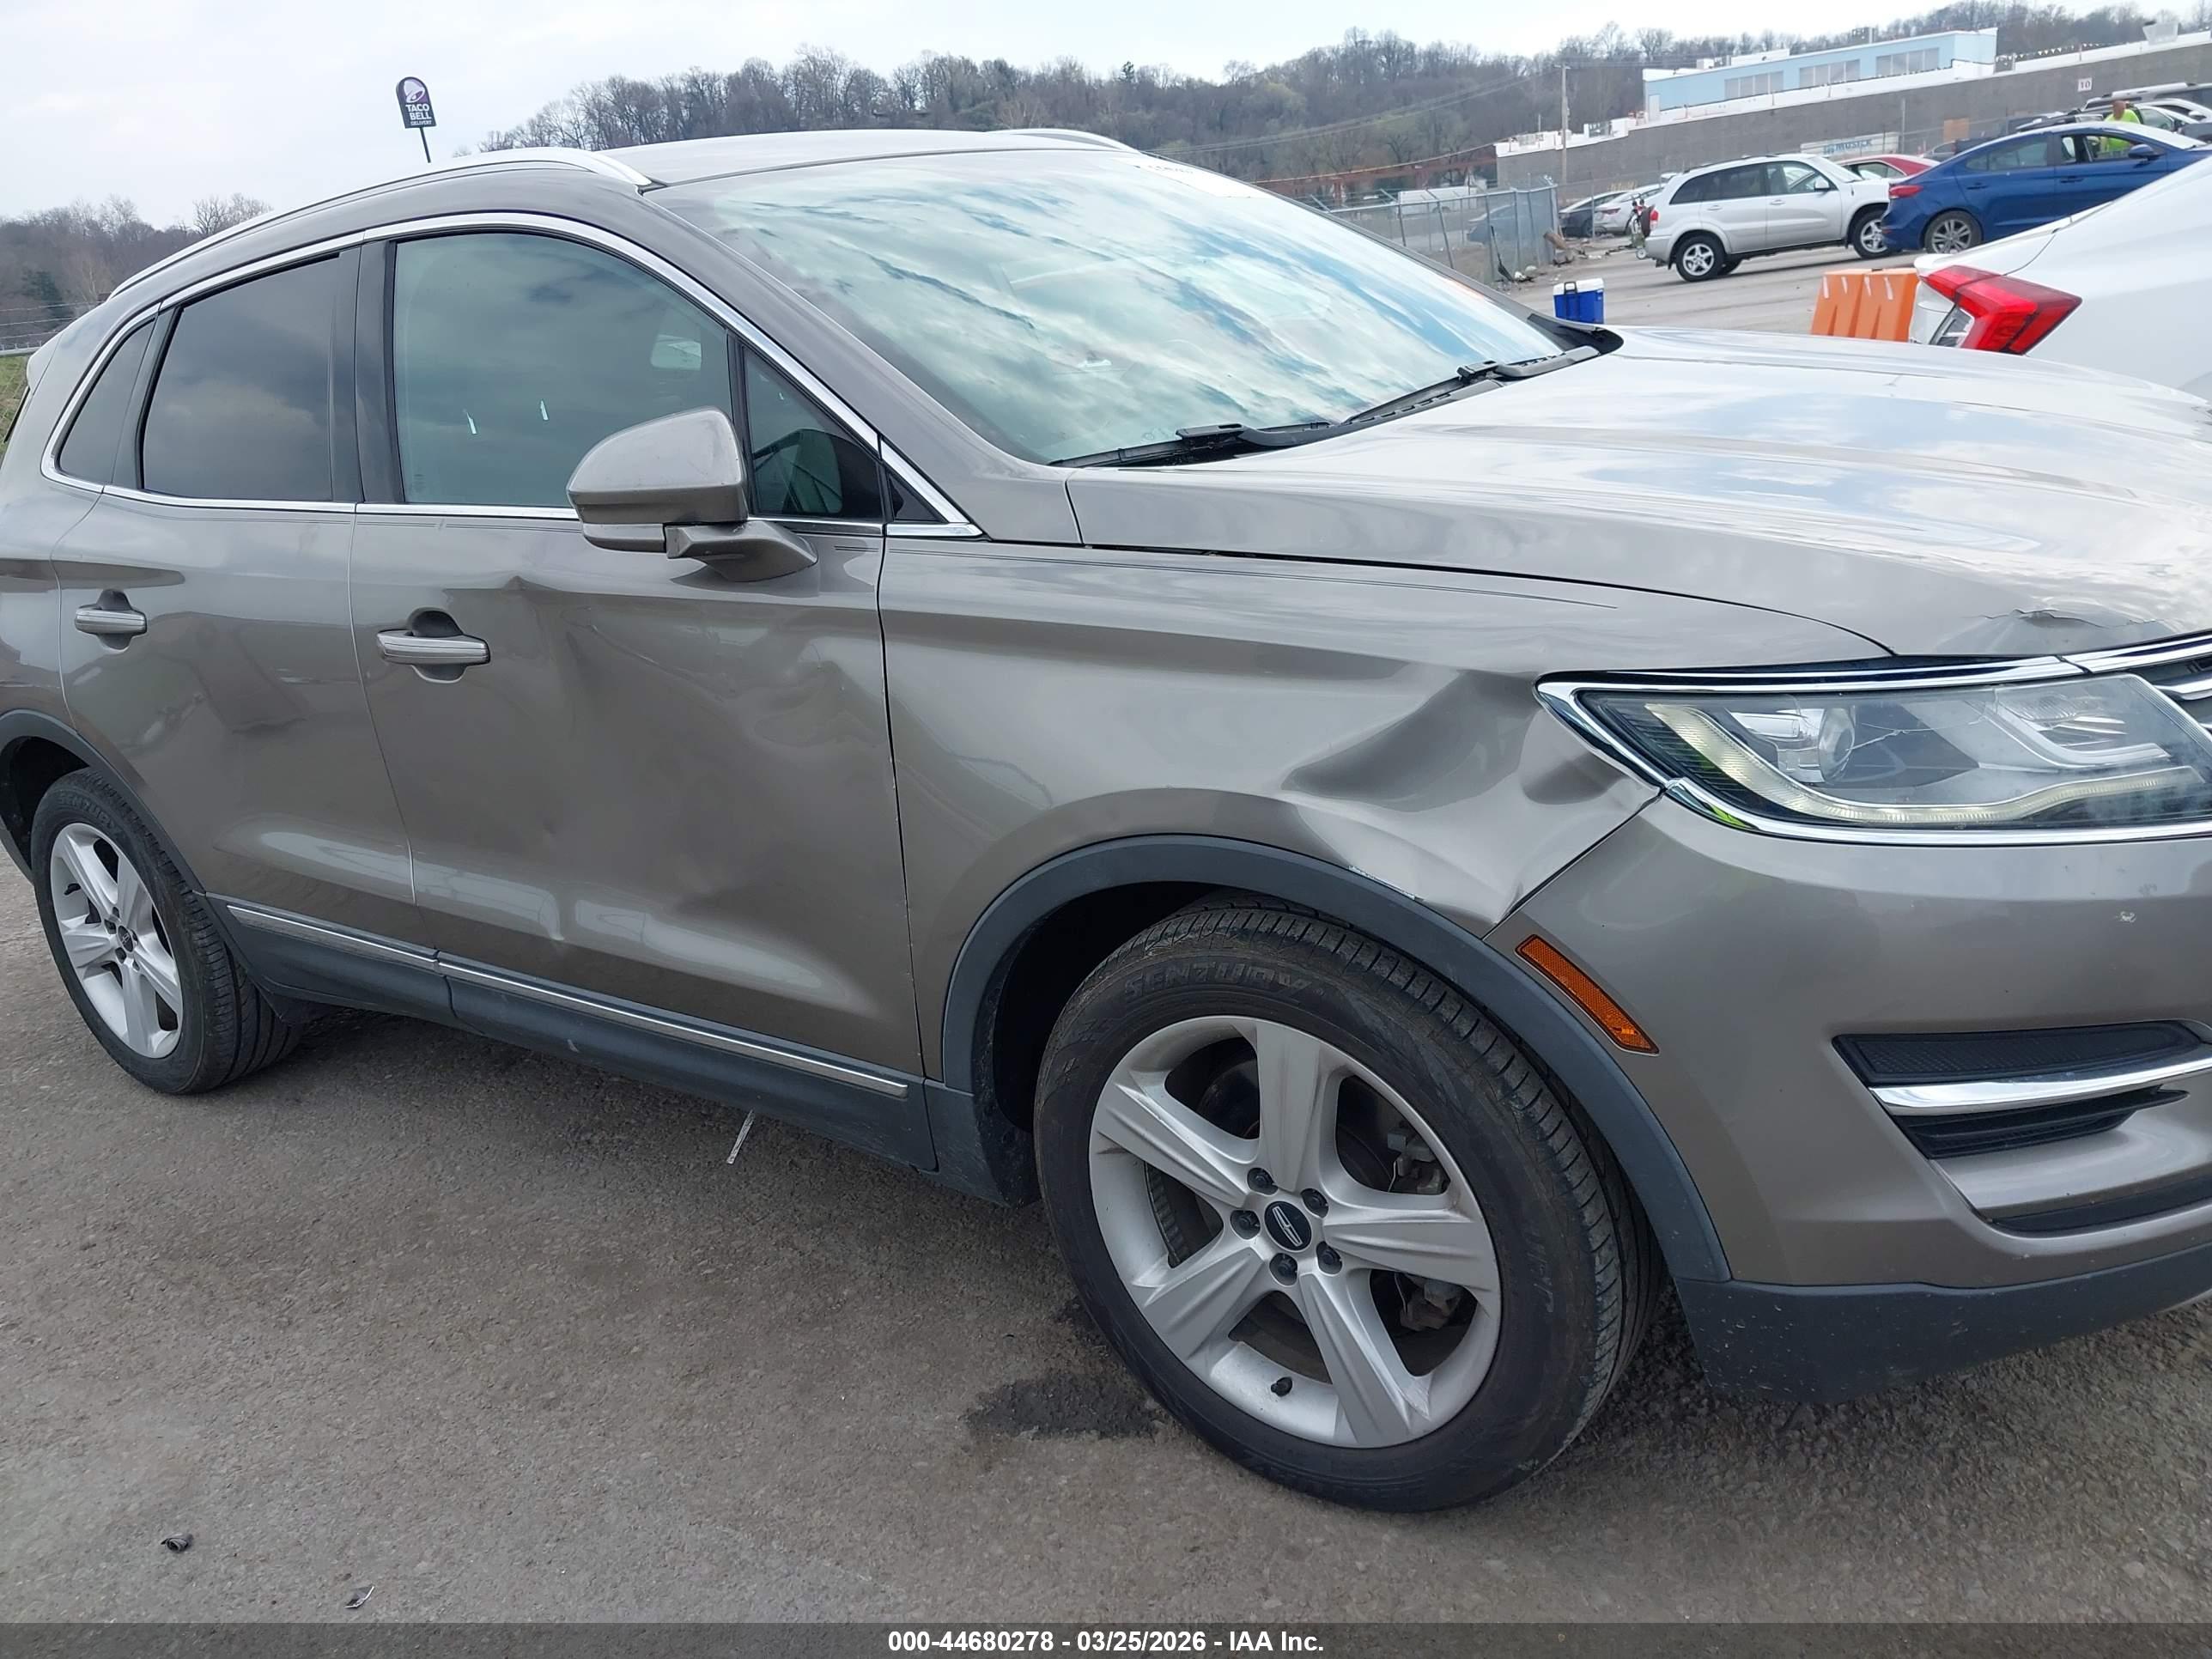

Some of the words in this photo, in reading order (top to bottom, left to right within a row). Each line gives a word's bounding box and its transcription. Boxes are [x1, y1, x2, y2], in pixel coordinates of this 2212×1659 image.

[2081, 80, 2091, 89] 10
[405, 103, 429, 112] TACO
[409, 112, 432, 120] BELL
